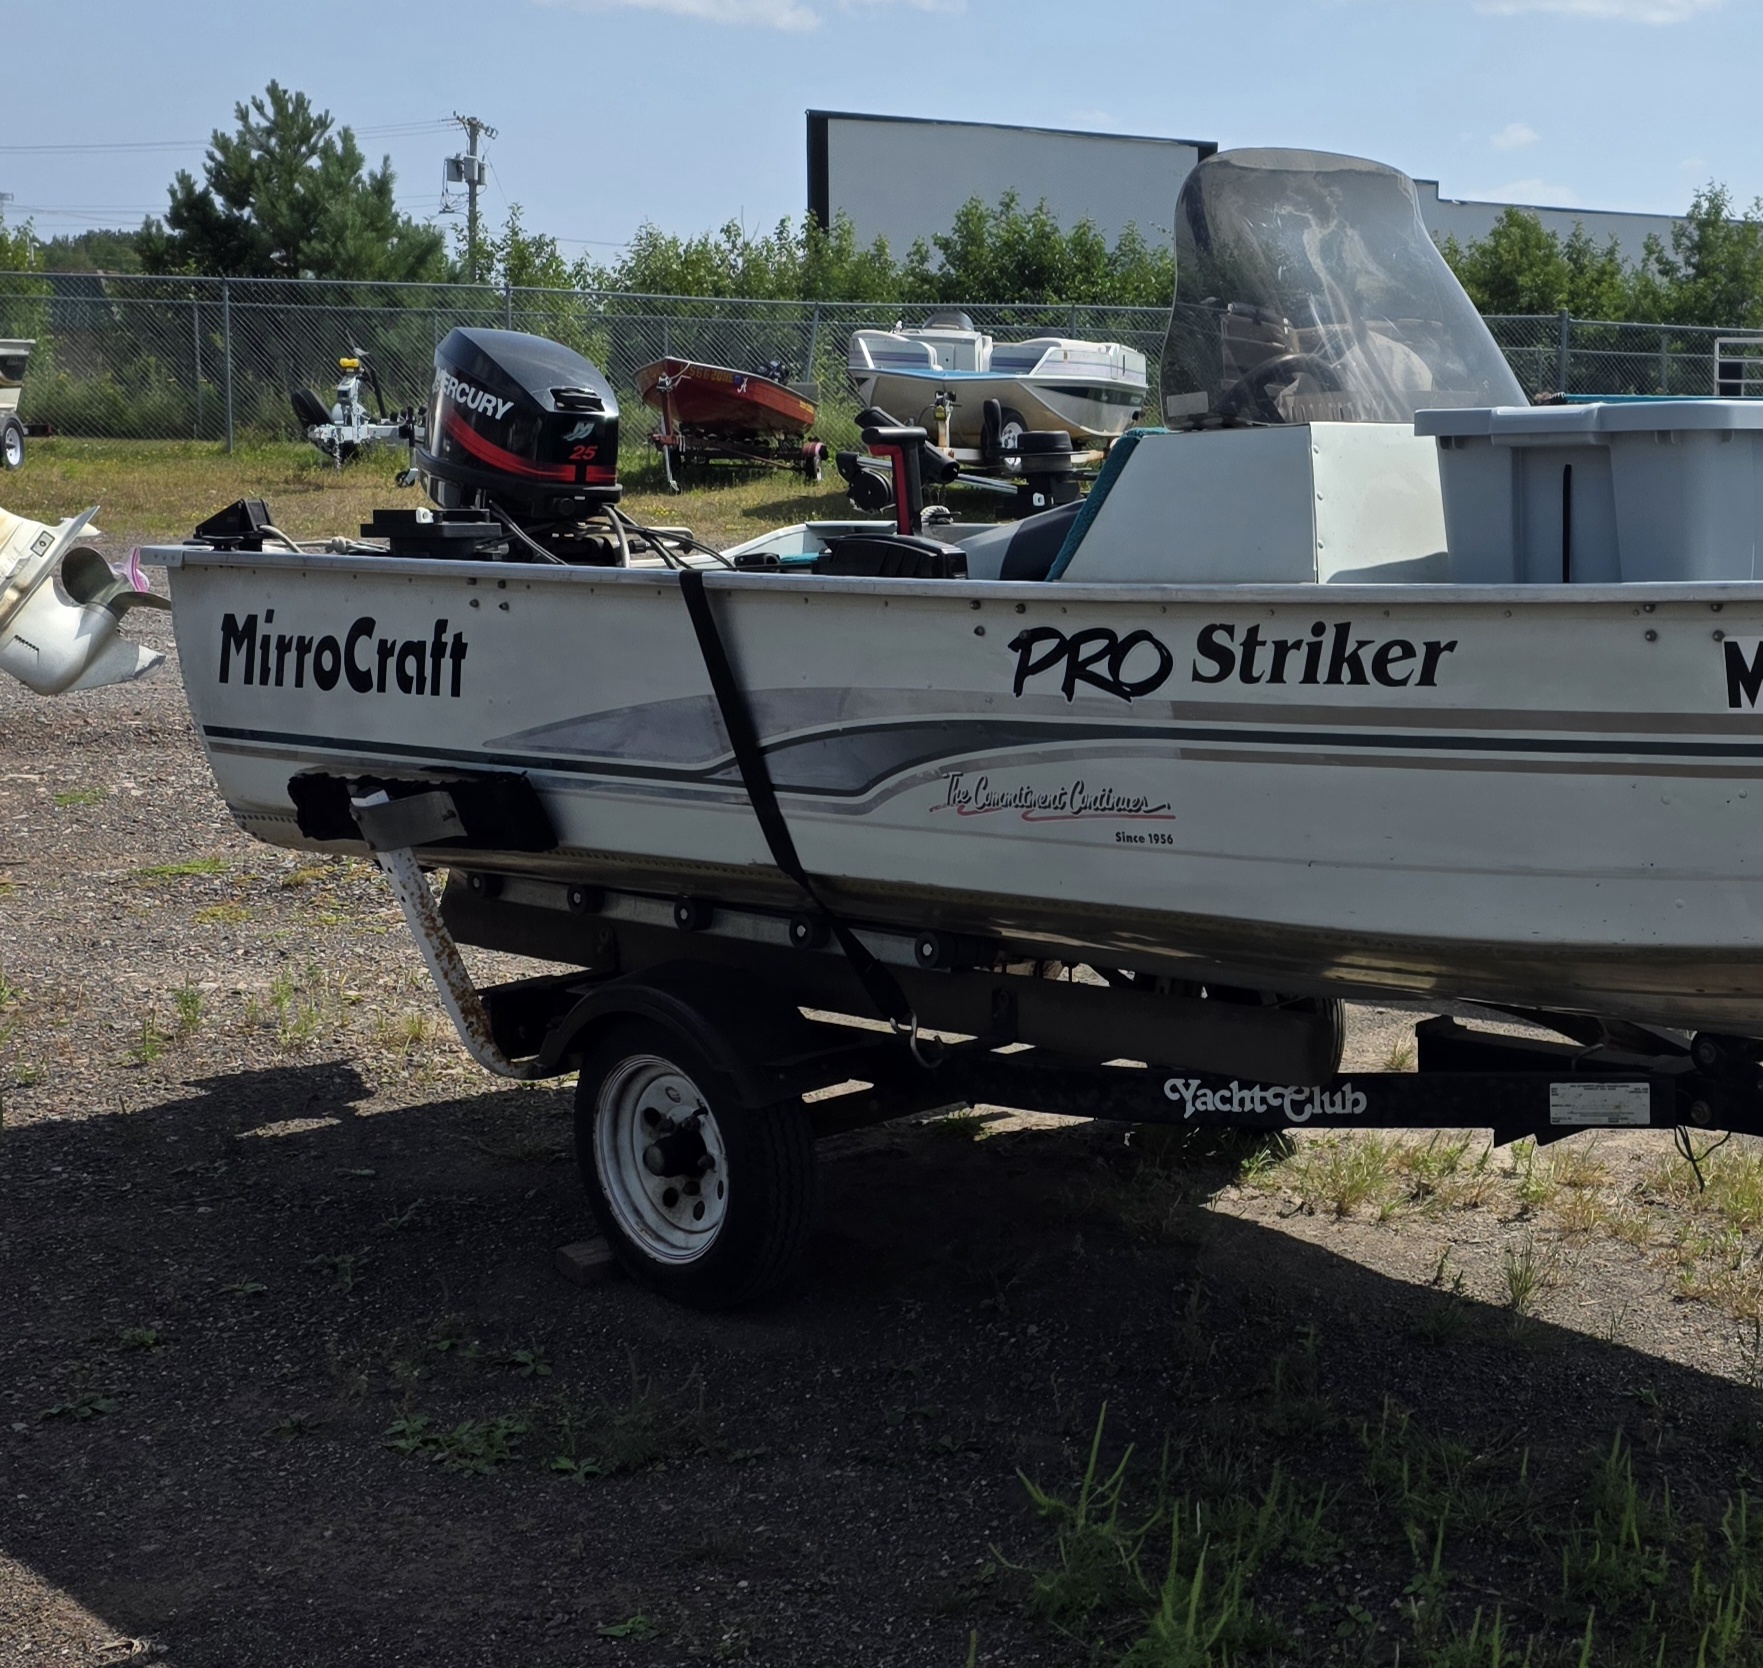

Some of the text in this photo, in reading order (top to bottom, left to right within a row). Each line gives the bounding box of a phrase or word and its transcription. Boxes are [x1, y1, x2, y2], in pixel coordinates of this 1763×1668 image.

[432, 365, 515, 421] MERCURY
[568, 445, 598, 460] 25
[218, 608, 469, 698] MirroCraft
[1007, 620, 1459, 703] PRO Striker
[942, 771, 1168, 815] The Commitment Continues
[1115, 831, 1174, 846] Since 1956
